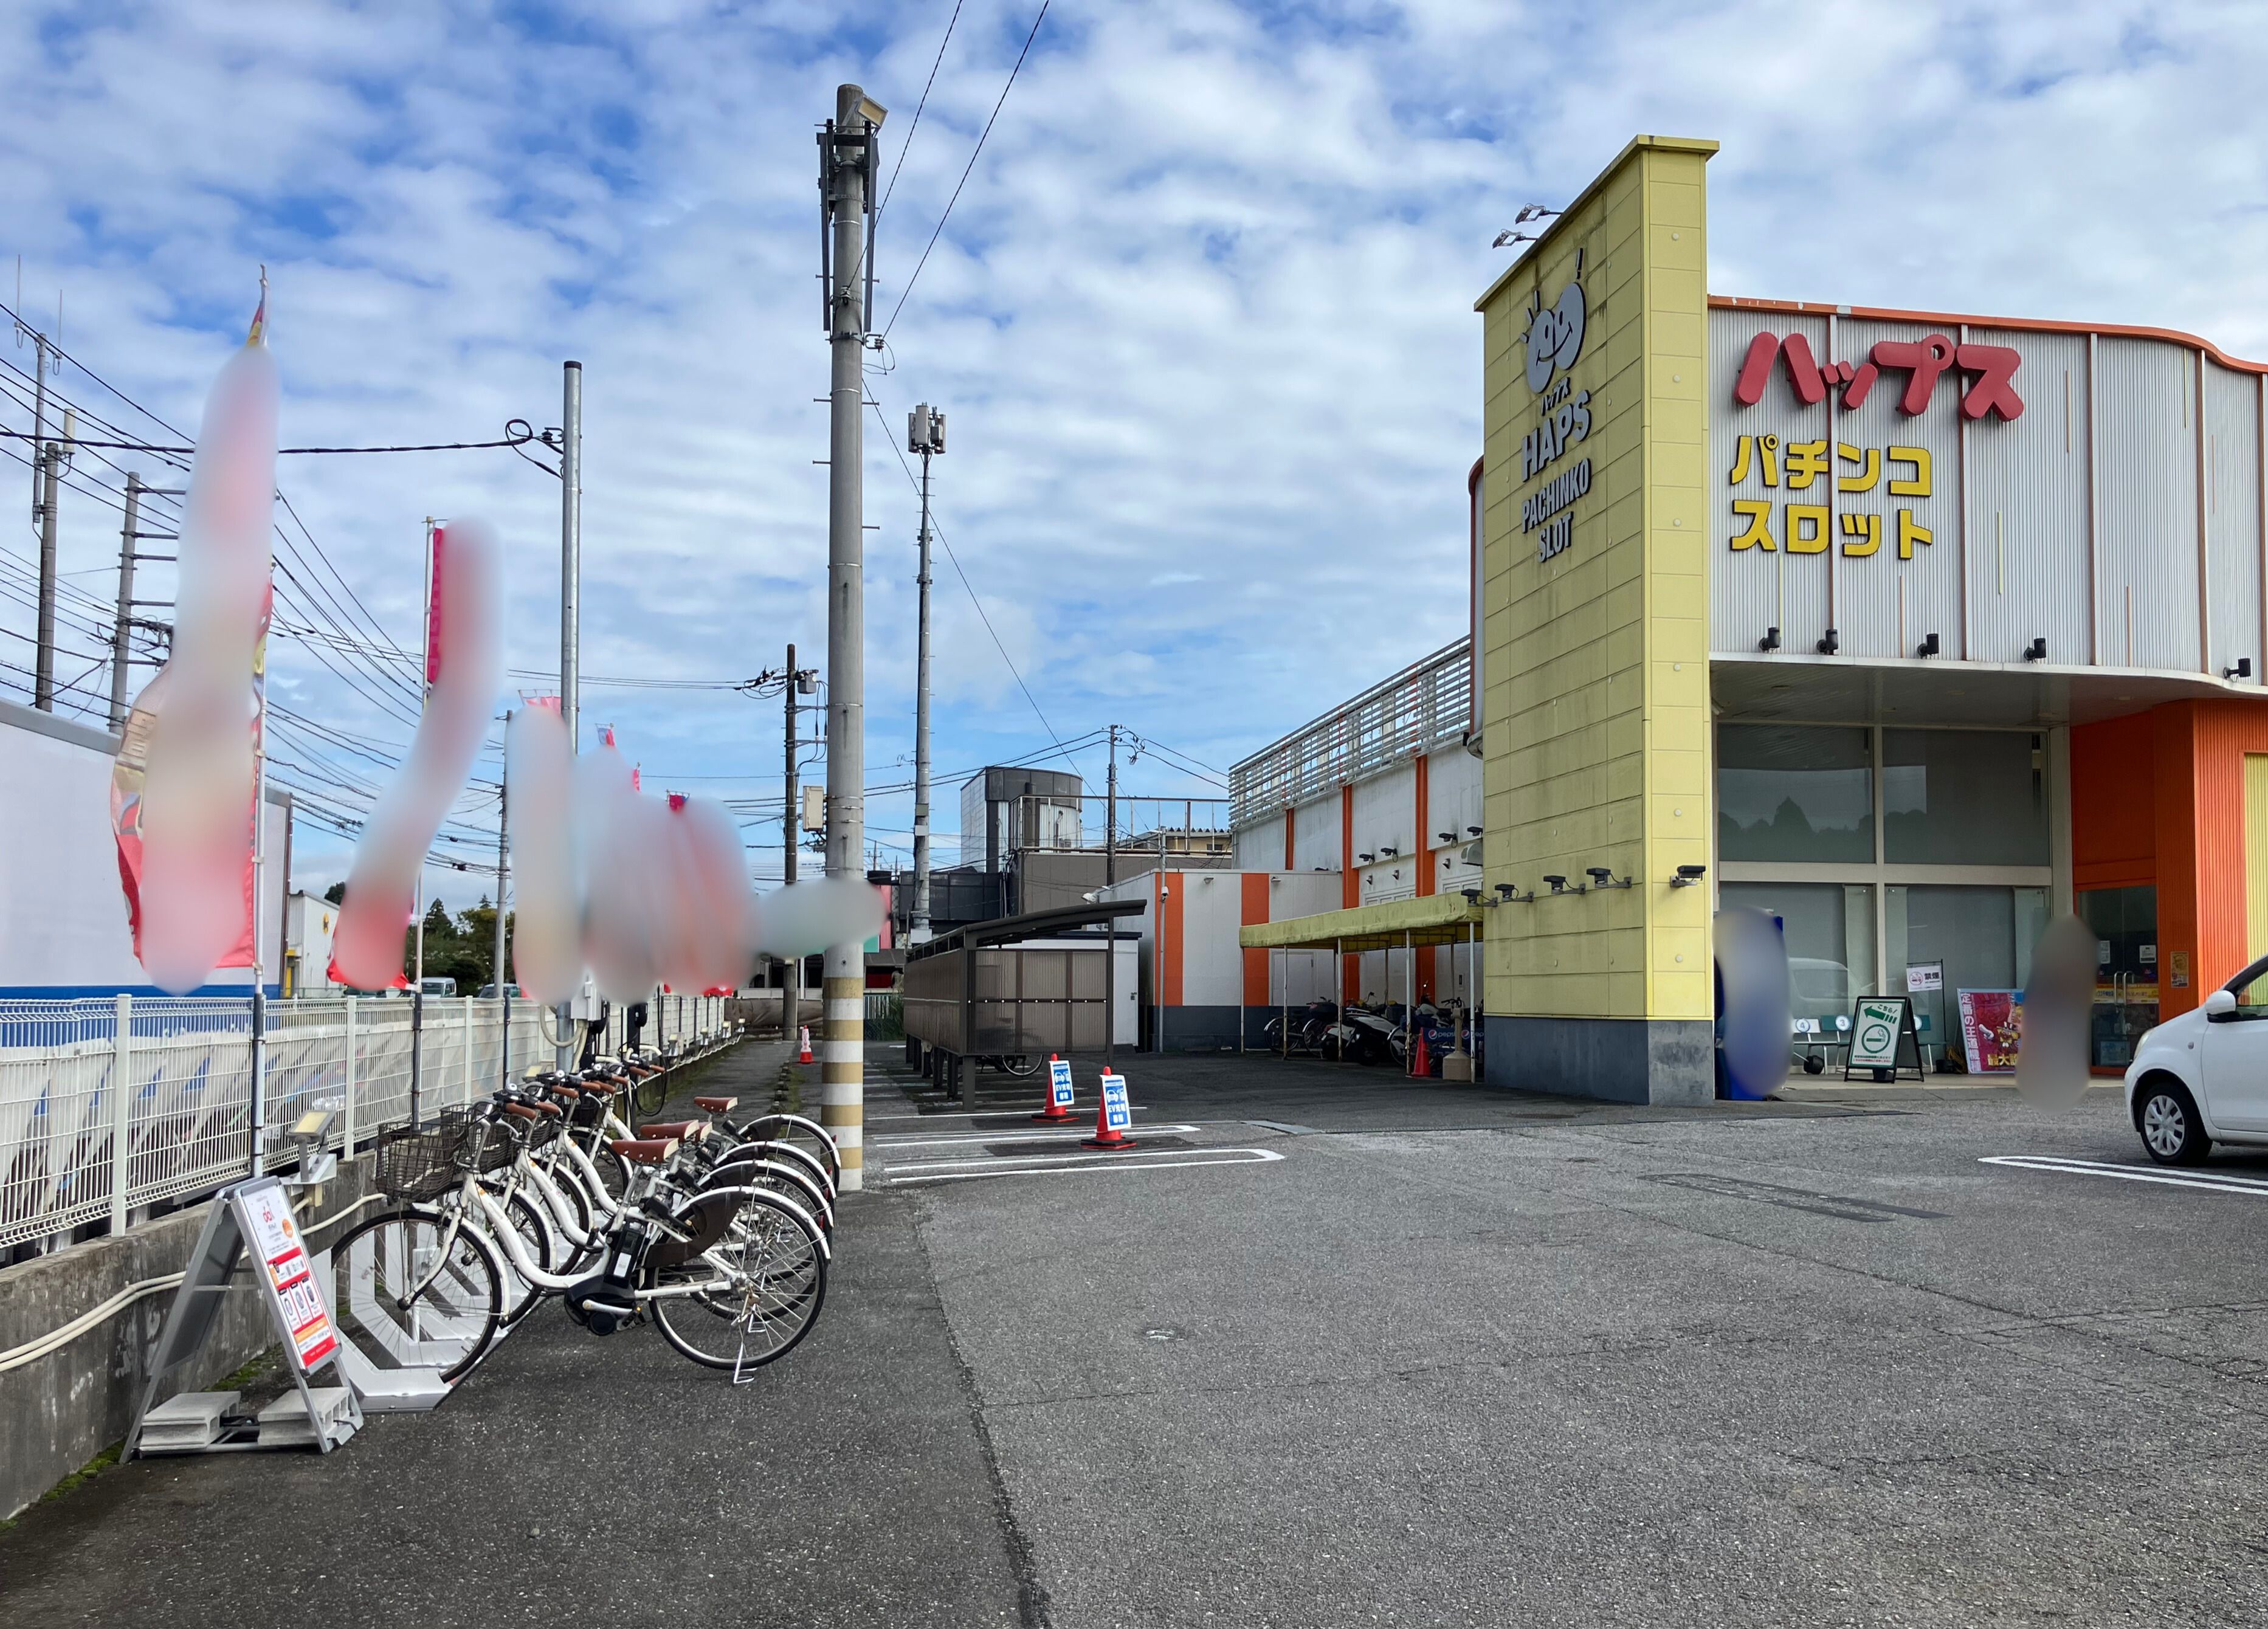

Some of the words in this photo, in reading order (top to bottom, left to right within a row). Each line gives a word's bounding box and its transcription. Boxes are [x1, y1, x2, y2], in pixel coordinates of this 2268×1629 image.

[1733, 331, 2025, 422] ハップス
[1522, 389, 1592, 483] HAPS
[1730, 433, 1932, 497] パチンコ
[1522, 457, 1592, 534] PACHINKO
[1730, 499, 1932, 560] スロット
[1537, 511, 1573, 563] SLOT
